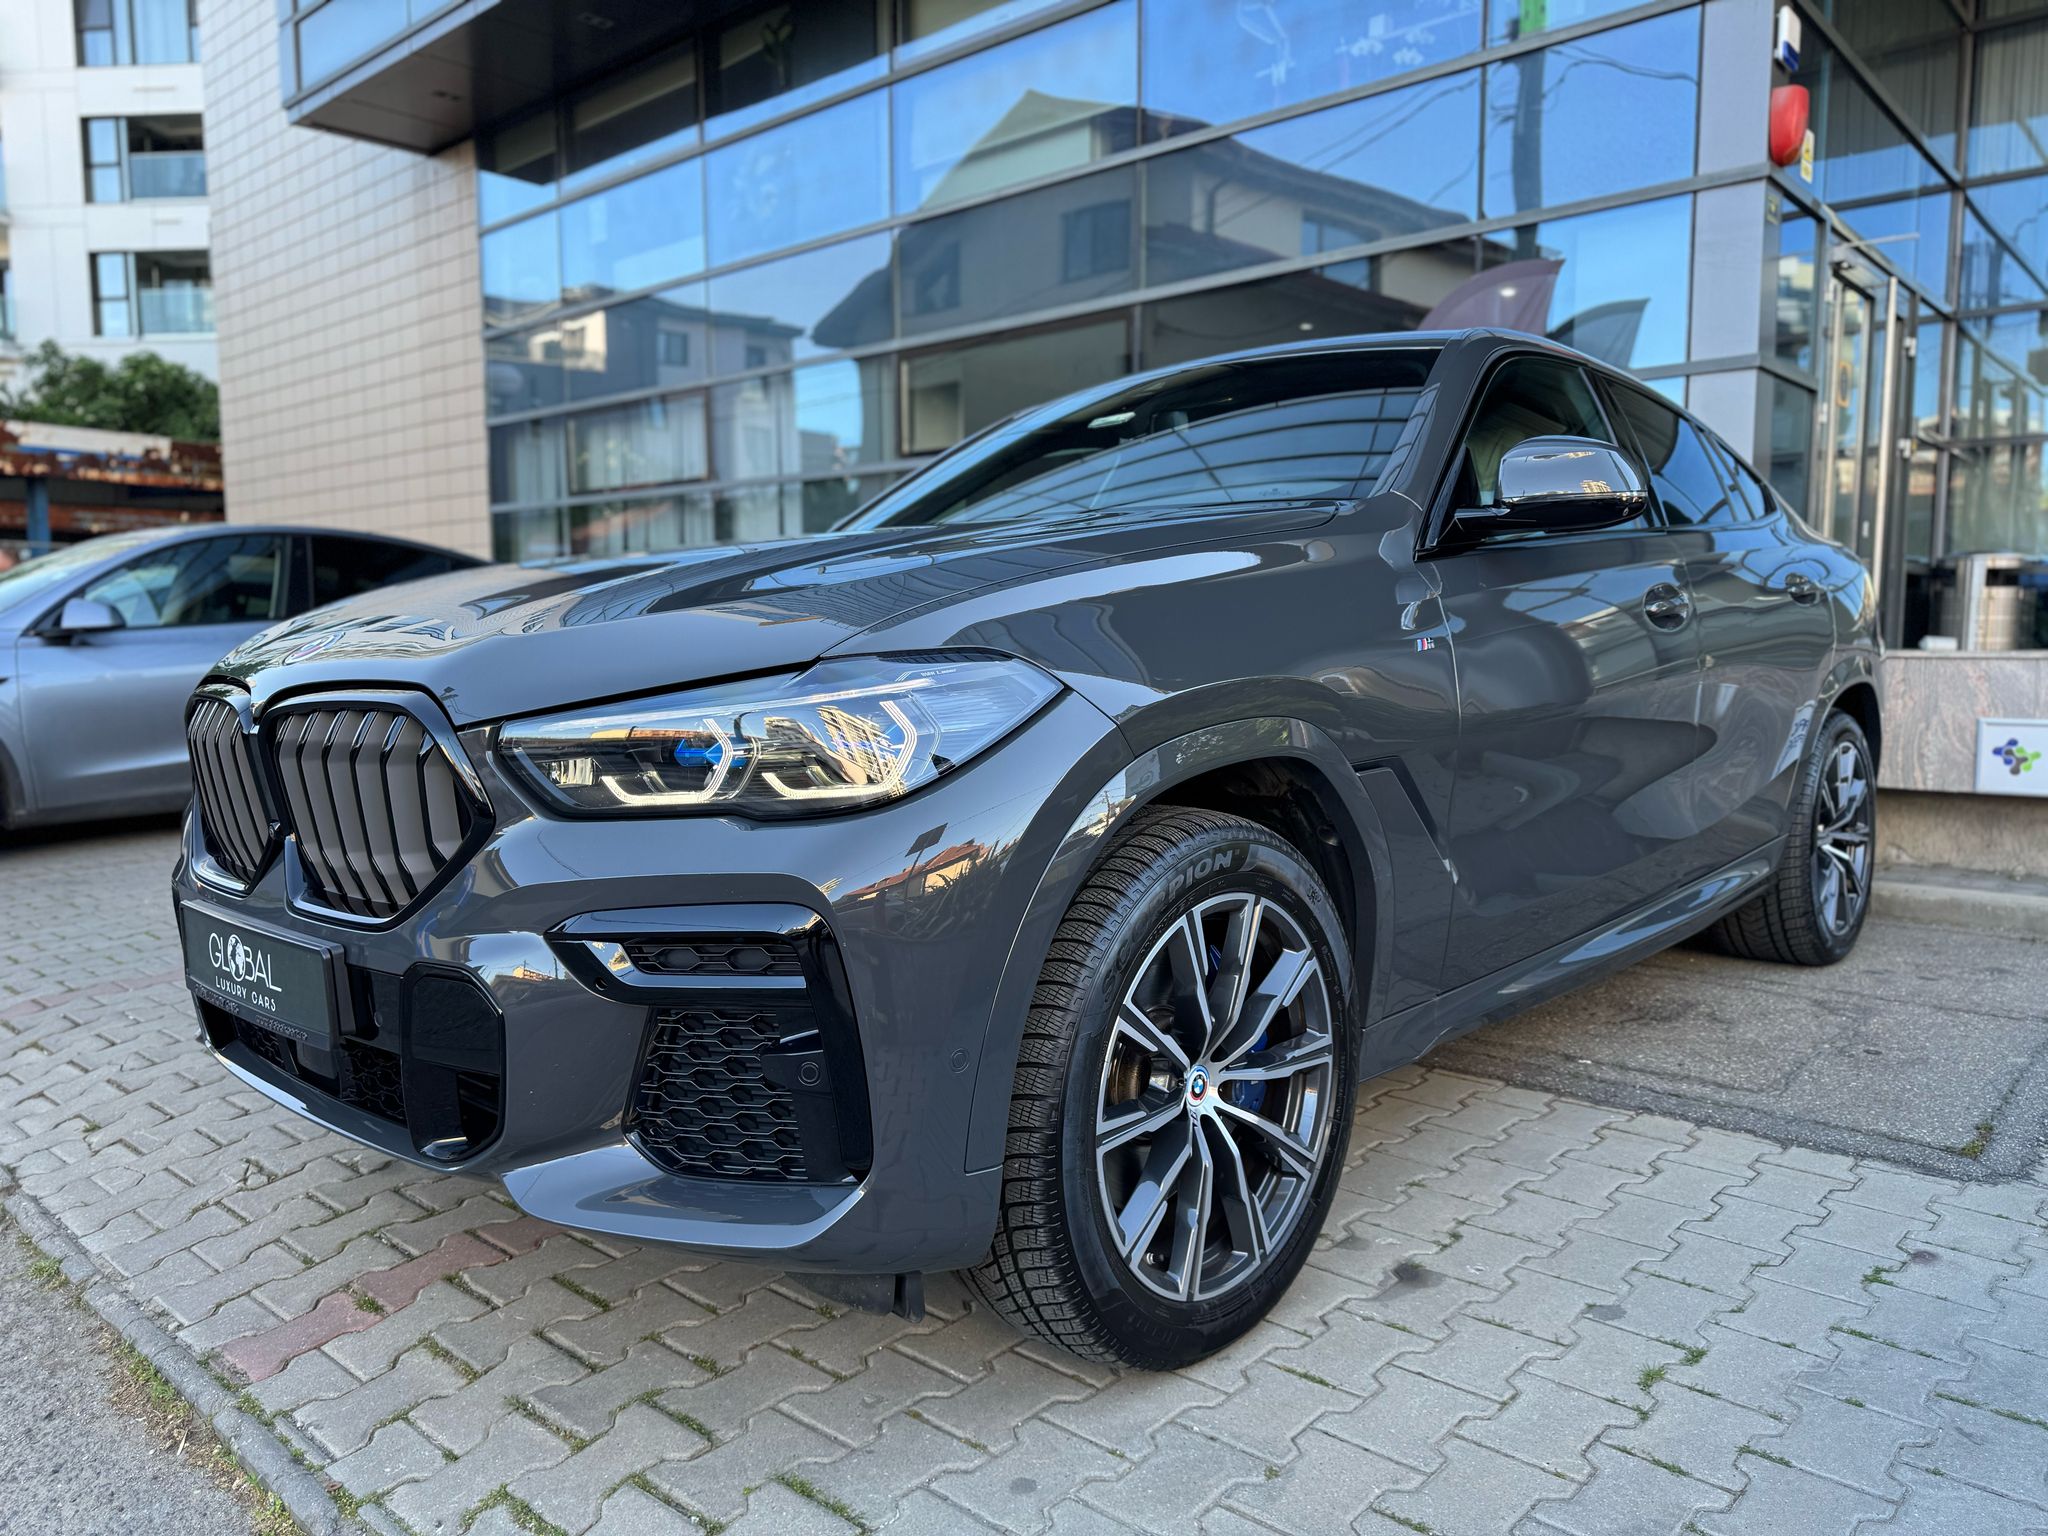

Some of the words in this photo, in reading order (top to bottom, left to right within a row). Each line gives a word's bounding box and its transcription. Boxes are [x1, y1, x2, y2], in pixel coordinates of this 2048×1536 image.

[209, 933, 282, 992] GLOBAL
[216, 976, 246, 999] LUXURY
[252, 992, 276, 1012] CARS
